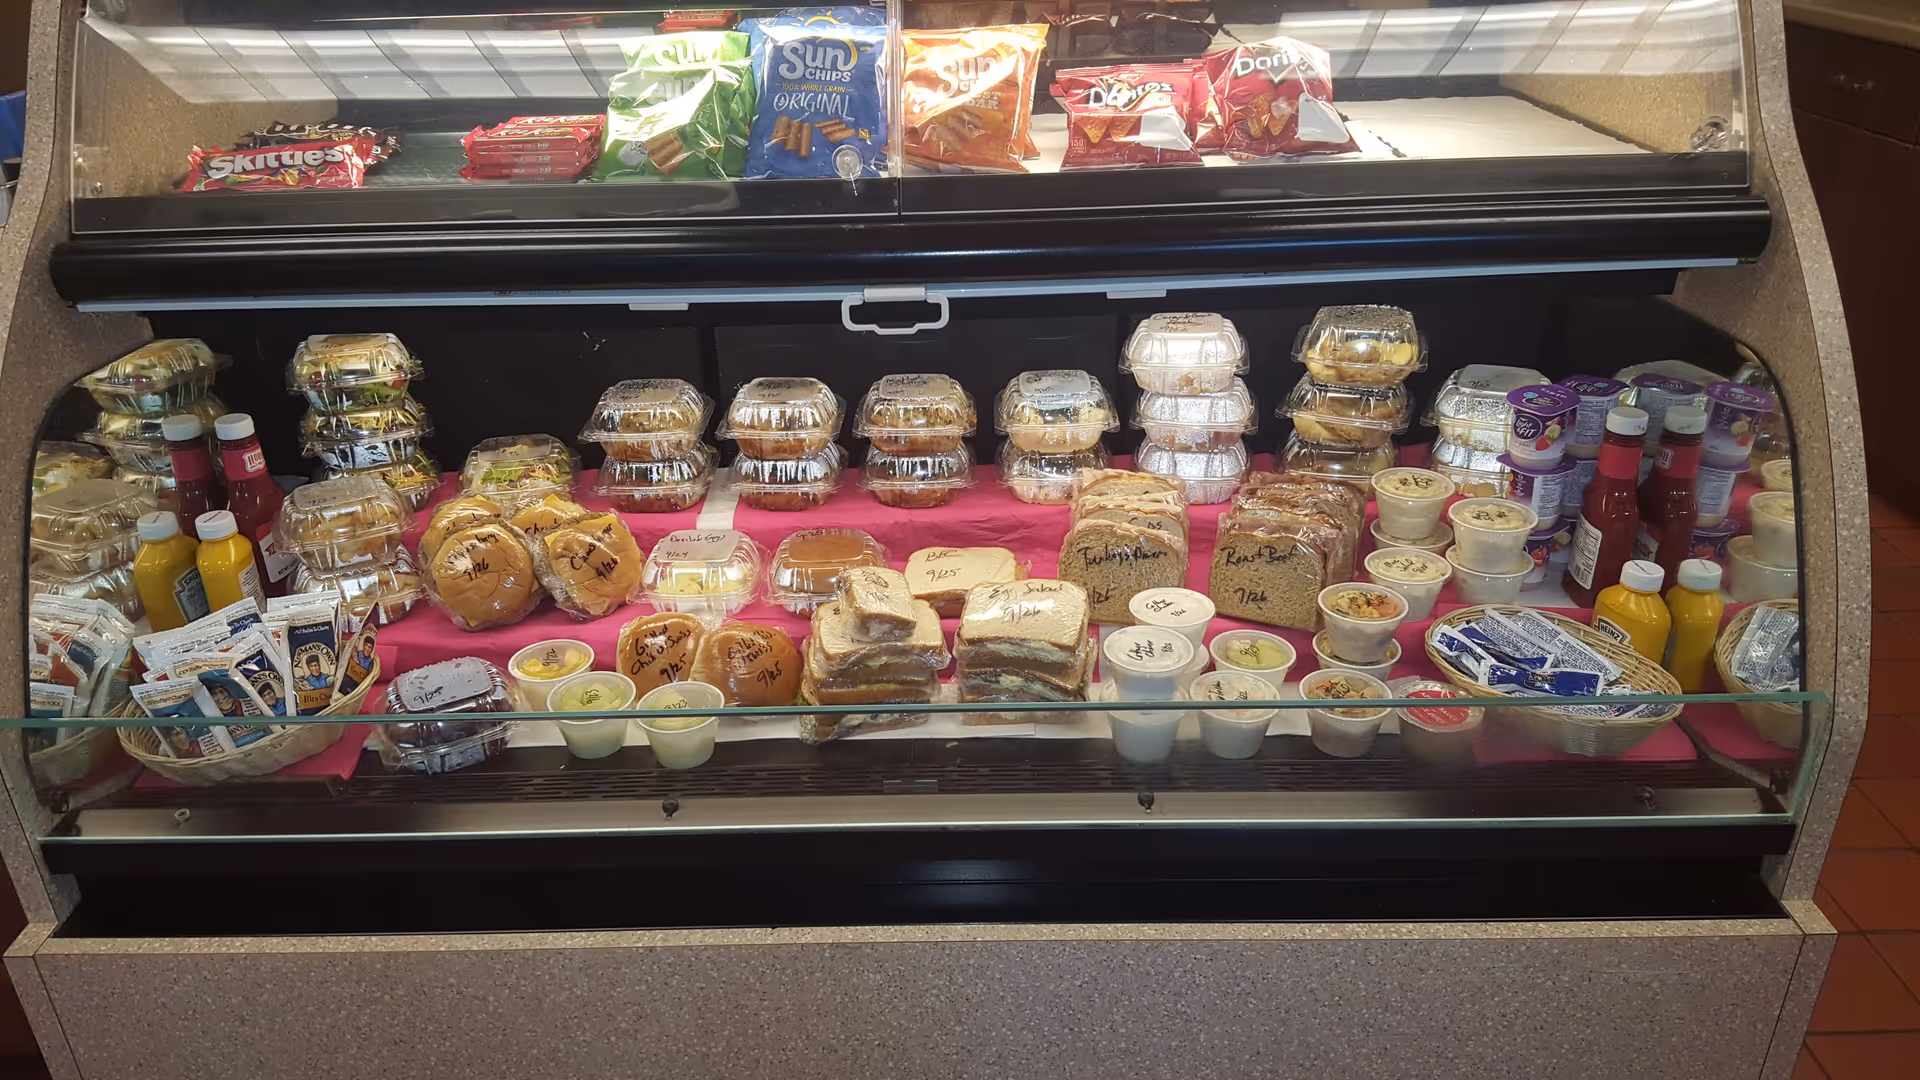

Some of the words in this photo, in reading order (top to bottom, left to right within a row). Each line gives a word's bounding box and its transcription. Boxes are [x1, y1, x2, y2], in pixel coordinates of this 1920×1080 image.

[778, 41, 854, 80] Sun
[805, 69, 852, 83] CHIPS
[781, 82, 800, 91] 100%
[801, 84, 823, 92] WHOLE
[1089, 82, 1173, 107] Doitos
[773, 92, 855, 121] ORIGINAL
[1070, 139, 1085, 148] 150
[208, 148, 345, 180] Skittles
[1515, 419, 1533, 430] Light
[1520, 428, 1537, 438] FIT
[1220, 546, 1263, 566] Roast
[1600, 623, 1621, 641] HEINZ
[303, 693, 319, 703] Bleu
